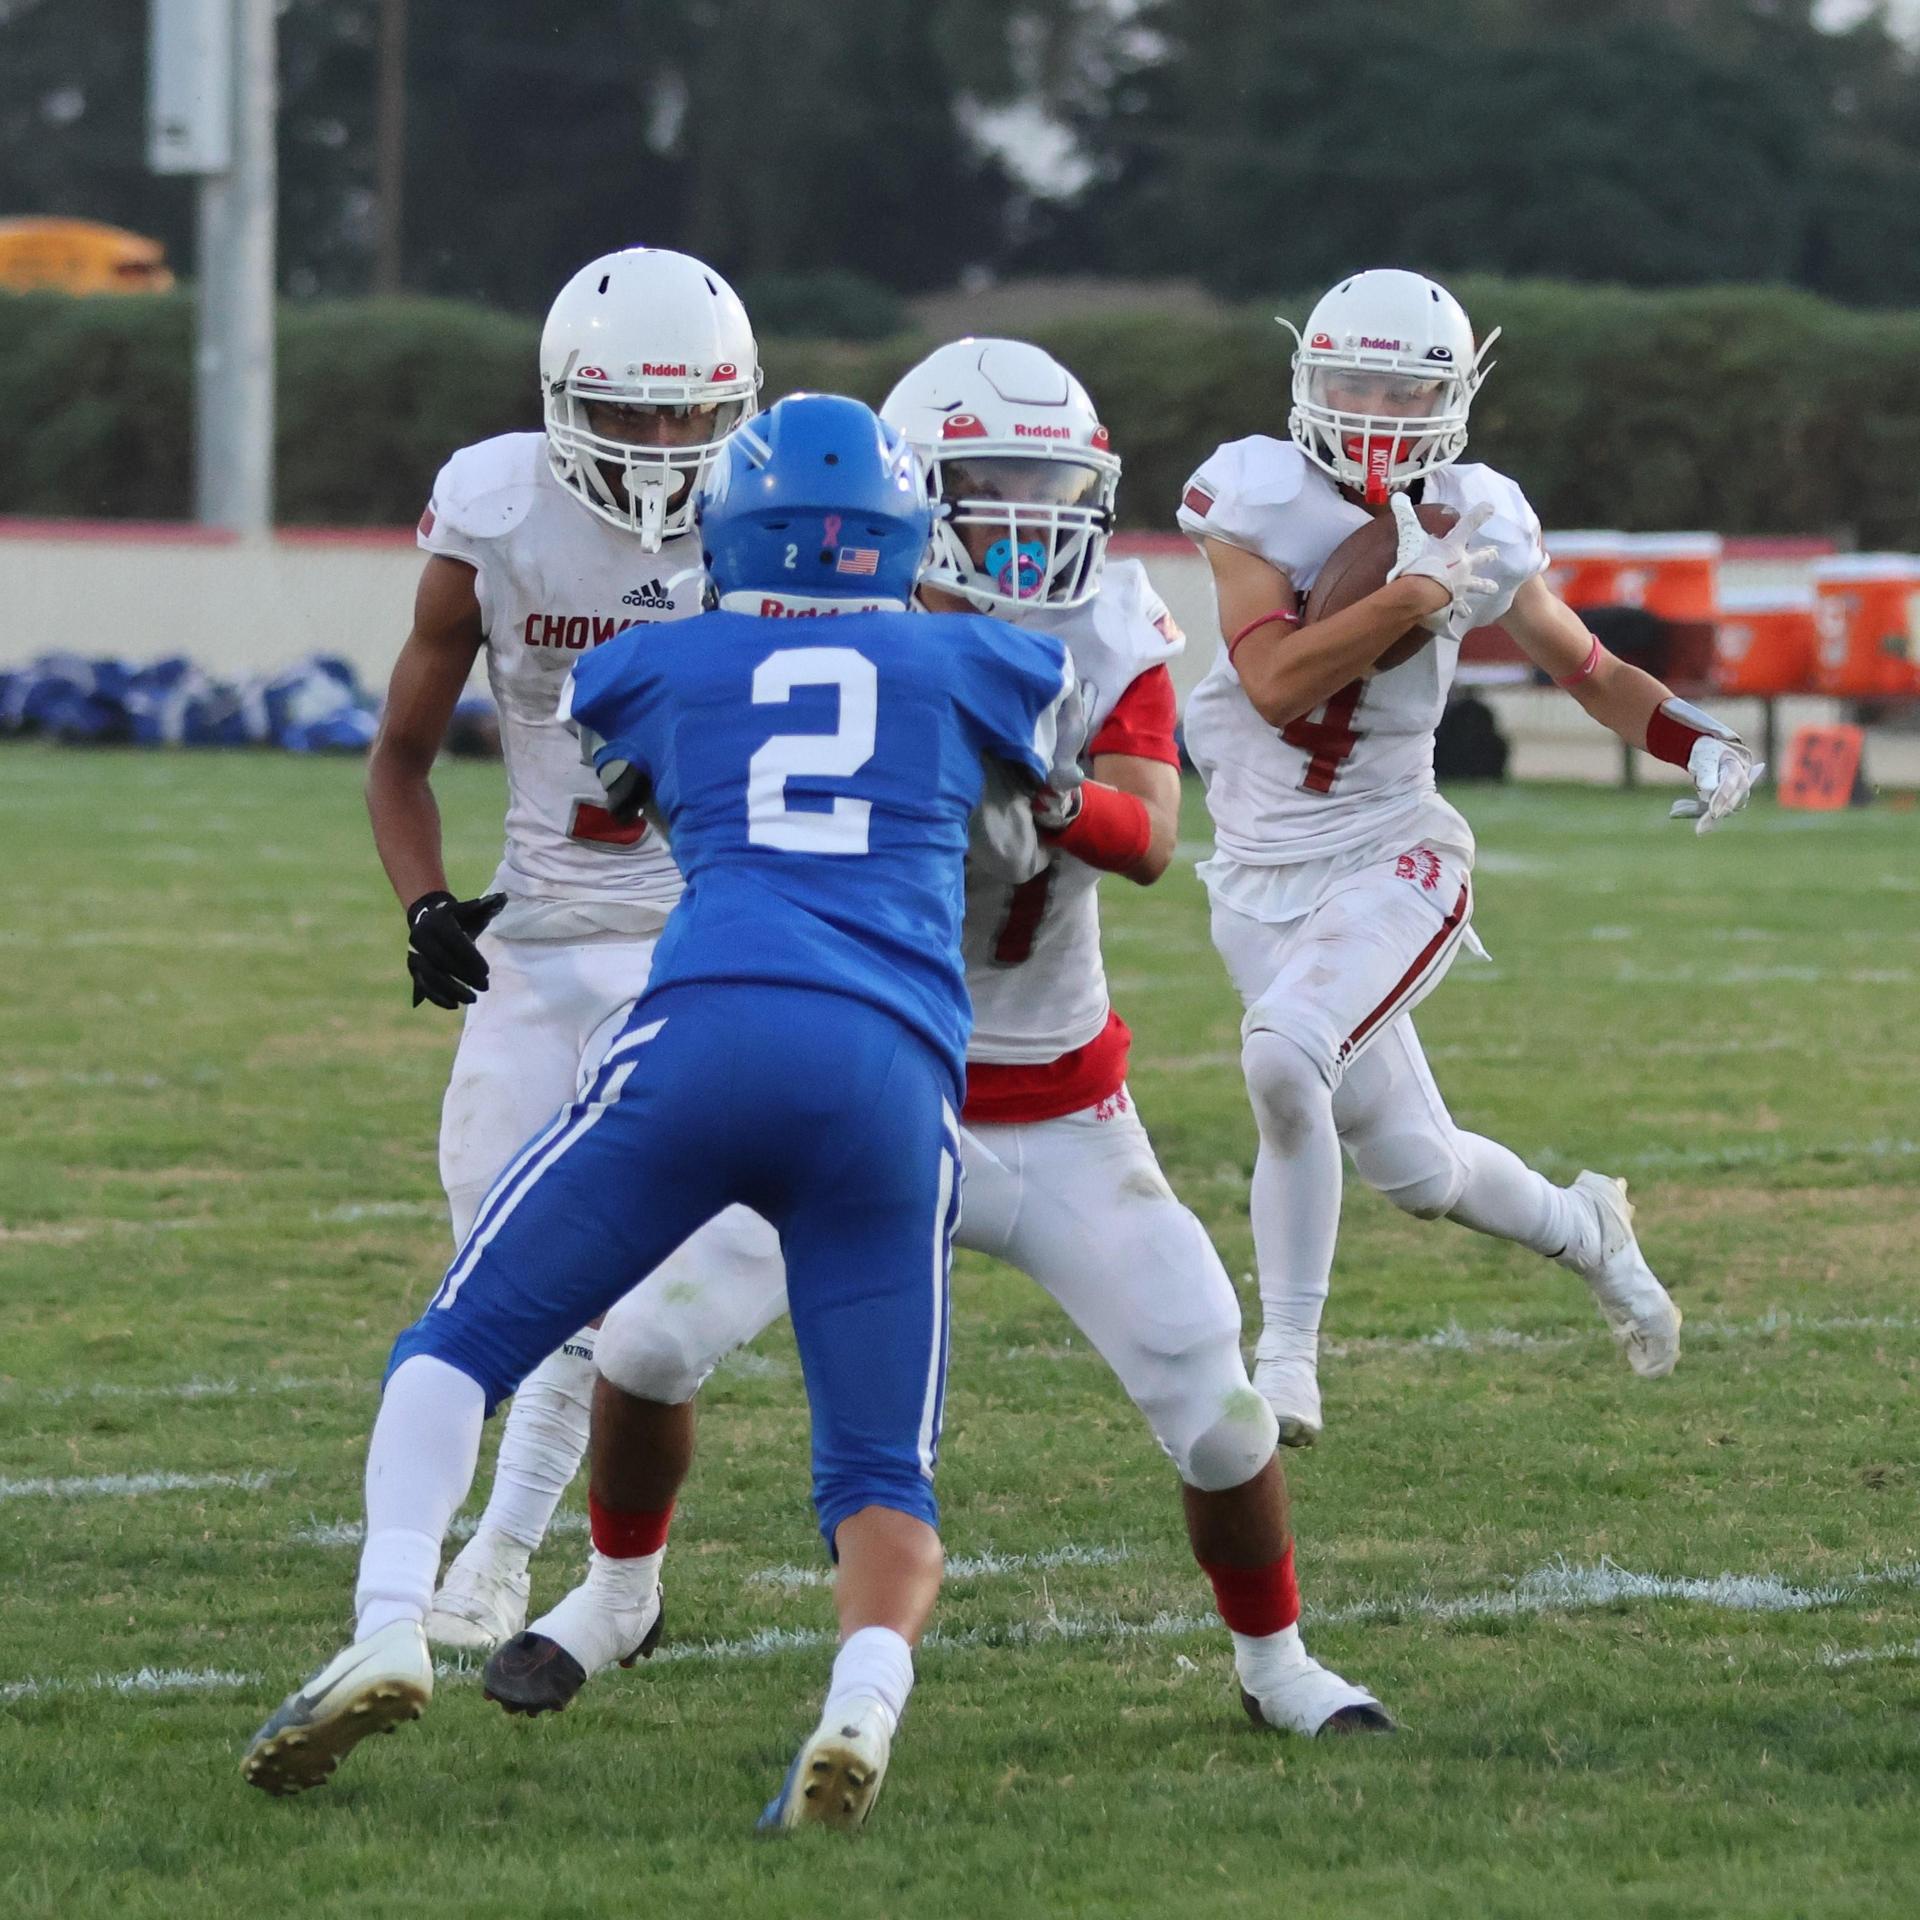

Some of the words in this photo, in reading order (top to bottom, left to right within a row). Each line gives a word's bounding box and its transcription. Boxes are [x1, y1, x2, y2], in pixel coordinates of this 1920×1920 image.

[1360, 336, 1400, 351] Riddell
[642, 363, 687, 377] Riddell
[1014, 423, 1071, 440] Riddell
[784, 543, 799, 569] 2
[622, 594, 676, 611] adidas
[525, 613, 662, 650] CHOW
[1279, 676, 1370, 797] 4
[748, 646, 878, 854] 2
